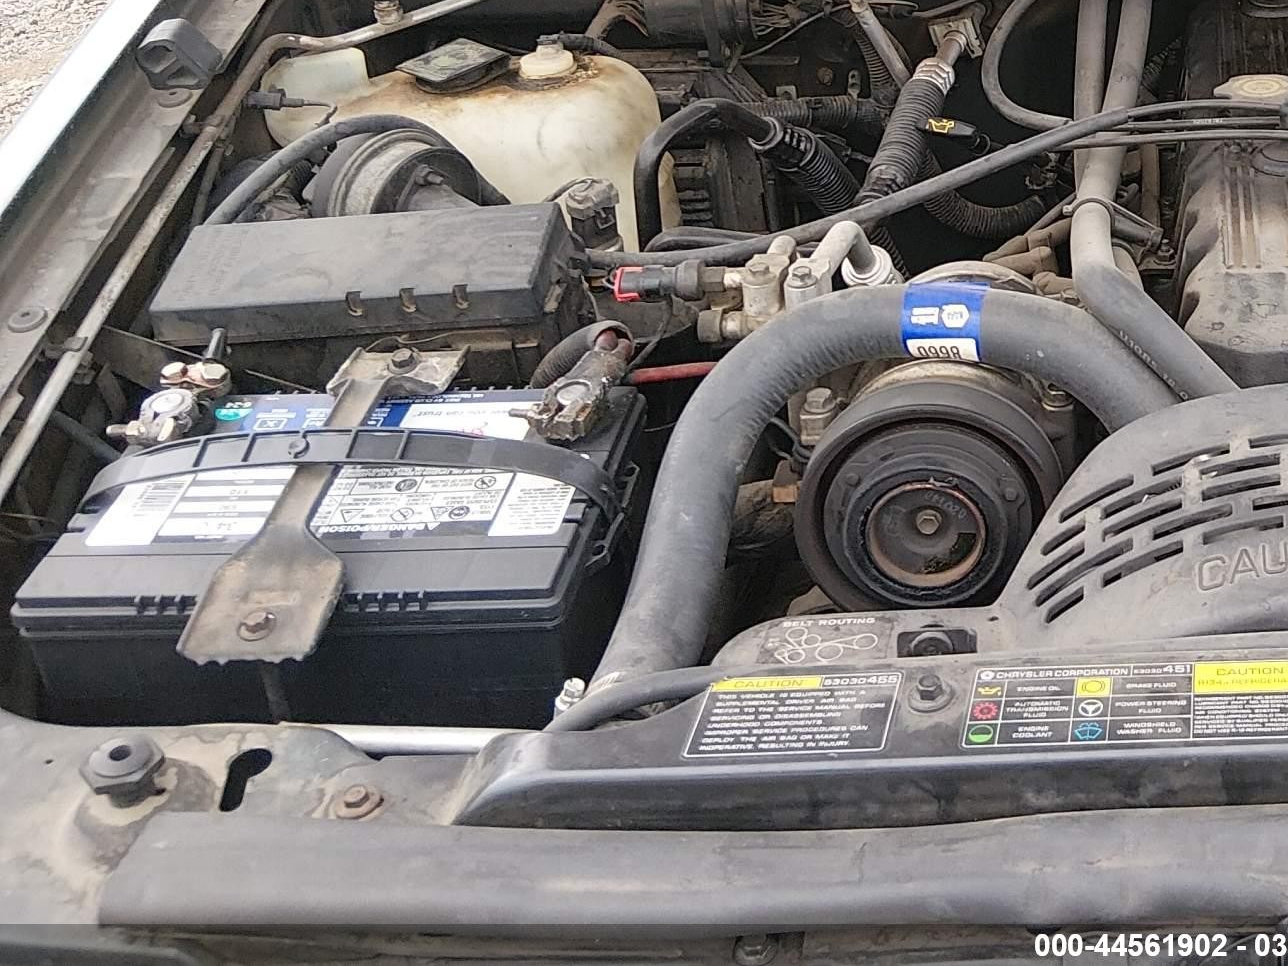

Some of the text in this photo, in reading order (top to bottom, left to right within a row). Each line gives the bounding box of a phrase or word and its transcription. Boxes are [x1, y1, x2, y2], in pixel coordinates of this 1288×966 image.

[783, 617, 876, 628] BELT ROUTING
[996, 665, 1191, 679] CHRYSLER CORPORATION 53030451
[1216, 667, 1285, 677] CAUTION
[733, 675, 899, 689] CAUTION 53030455
[790, 690, 830, 698] EQUIPPED
[777, 705, 813, 713] SERVICE
[774, 711, 842, 720] DISASSEMBLING
[707, 719, 823, 729] UNDERHOOD COMPONENTS
[791, 725, 847, 733] PROCEDURES
[758, 741, 804, 749] RESULTING
